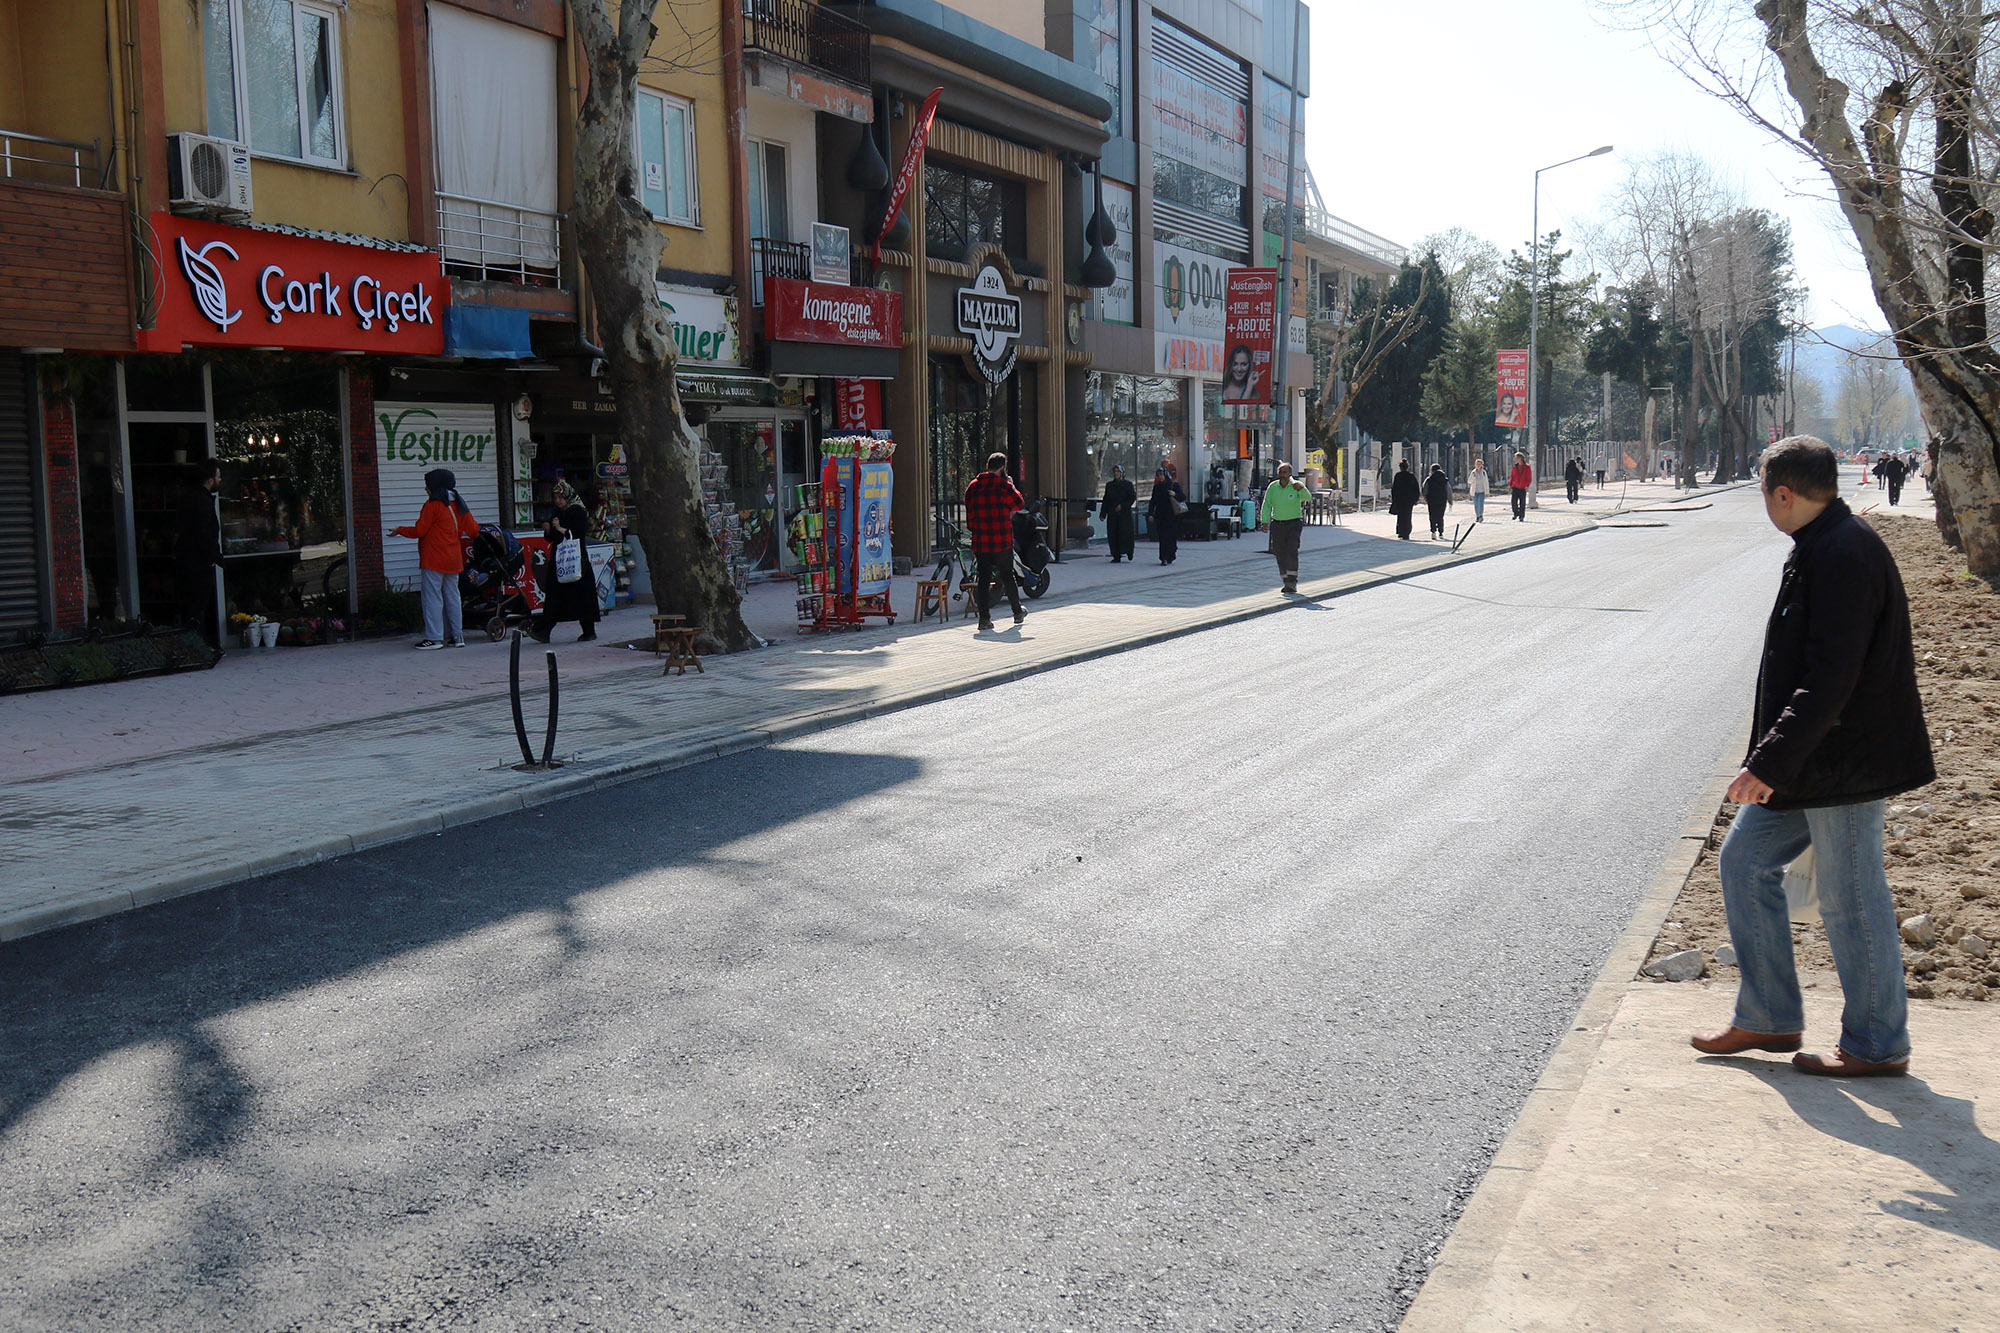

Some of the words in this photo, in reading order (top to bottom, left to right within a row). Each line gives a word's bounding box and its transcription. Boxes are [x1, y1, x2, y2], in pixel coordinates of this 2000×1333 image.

[983, 276, 999, 290] 1924
[1230, 280, 1273, 294] Justenglish
[260, 264, 342, 325] Çark
[351, 274, 434, 333] Çiçek
[802, 287, 871, 333] komagene
[963, 298, 1017, 333] MAZLUM
[1236, 318, 1272, 332] ABD'DE
[1168, 338, 1207, 371] AYDA
[572, 400, 587, 411] HER
[378, 407, 492, 467] Yeşiller
[604, 464, 629, 474] HARIBO
